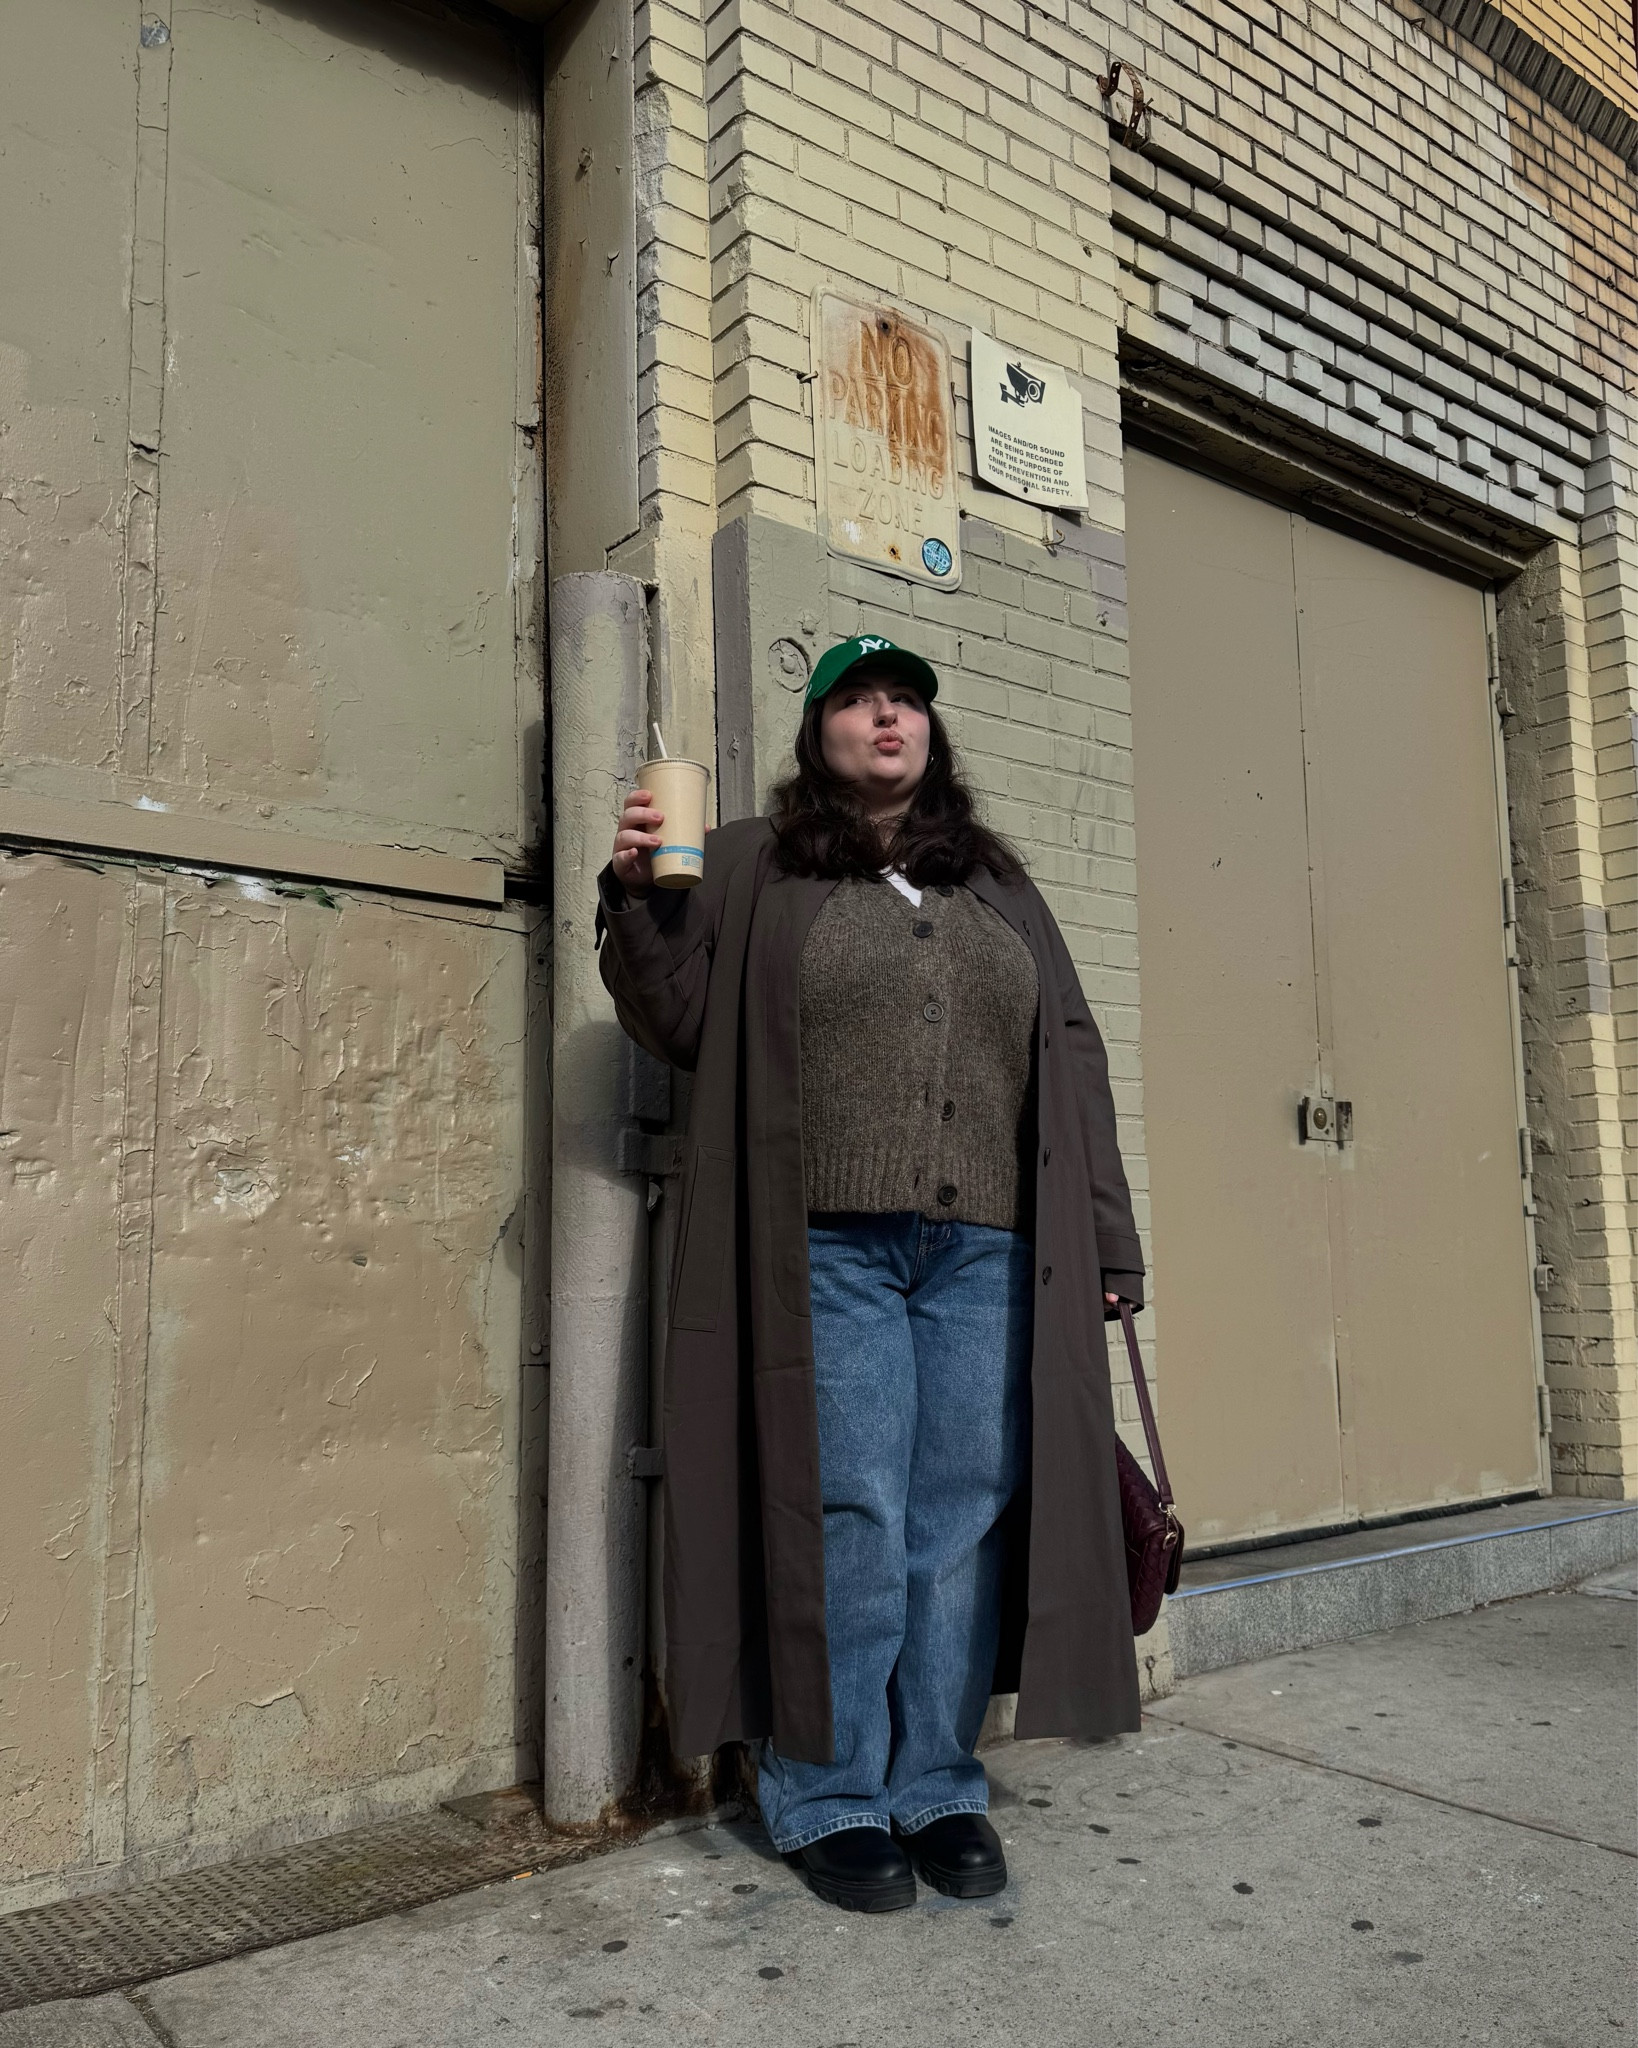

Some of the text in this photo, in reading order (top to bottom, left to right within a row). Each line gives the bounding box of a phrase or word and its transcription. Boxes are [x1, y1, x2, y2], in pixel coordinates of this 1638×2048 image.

[860, 321, 912, 386] NO
[829, 370, 945, 458] PARKING
[988, 425, 1065, 458] IMAGES AND/OR SOUND
[990, 436, 1064, 467] ARE BEING RECORDED
[832, 431, 944, 500] LOADING
[988, 454, 1070, 487] CRIME PREVENTION AND
[991, 446, 1004, 458] FOR
[1005, 453, 1018, 463] THE
[1019, 458, 1052, 474] PURPOSE
[987, 463, 1073, 497] YOUR PERSONAL SAFETY.
[858, 488, 924, 538] ZONE
